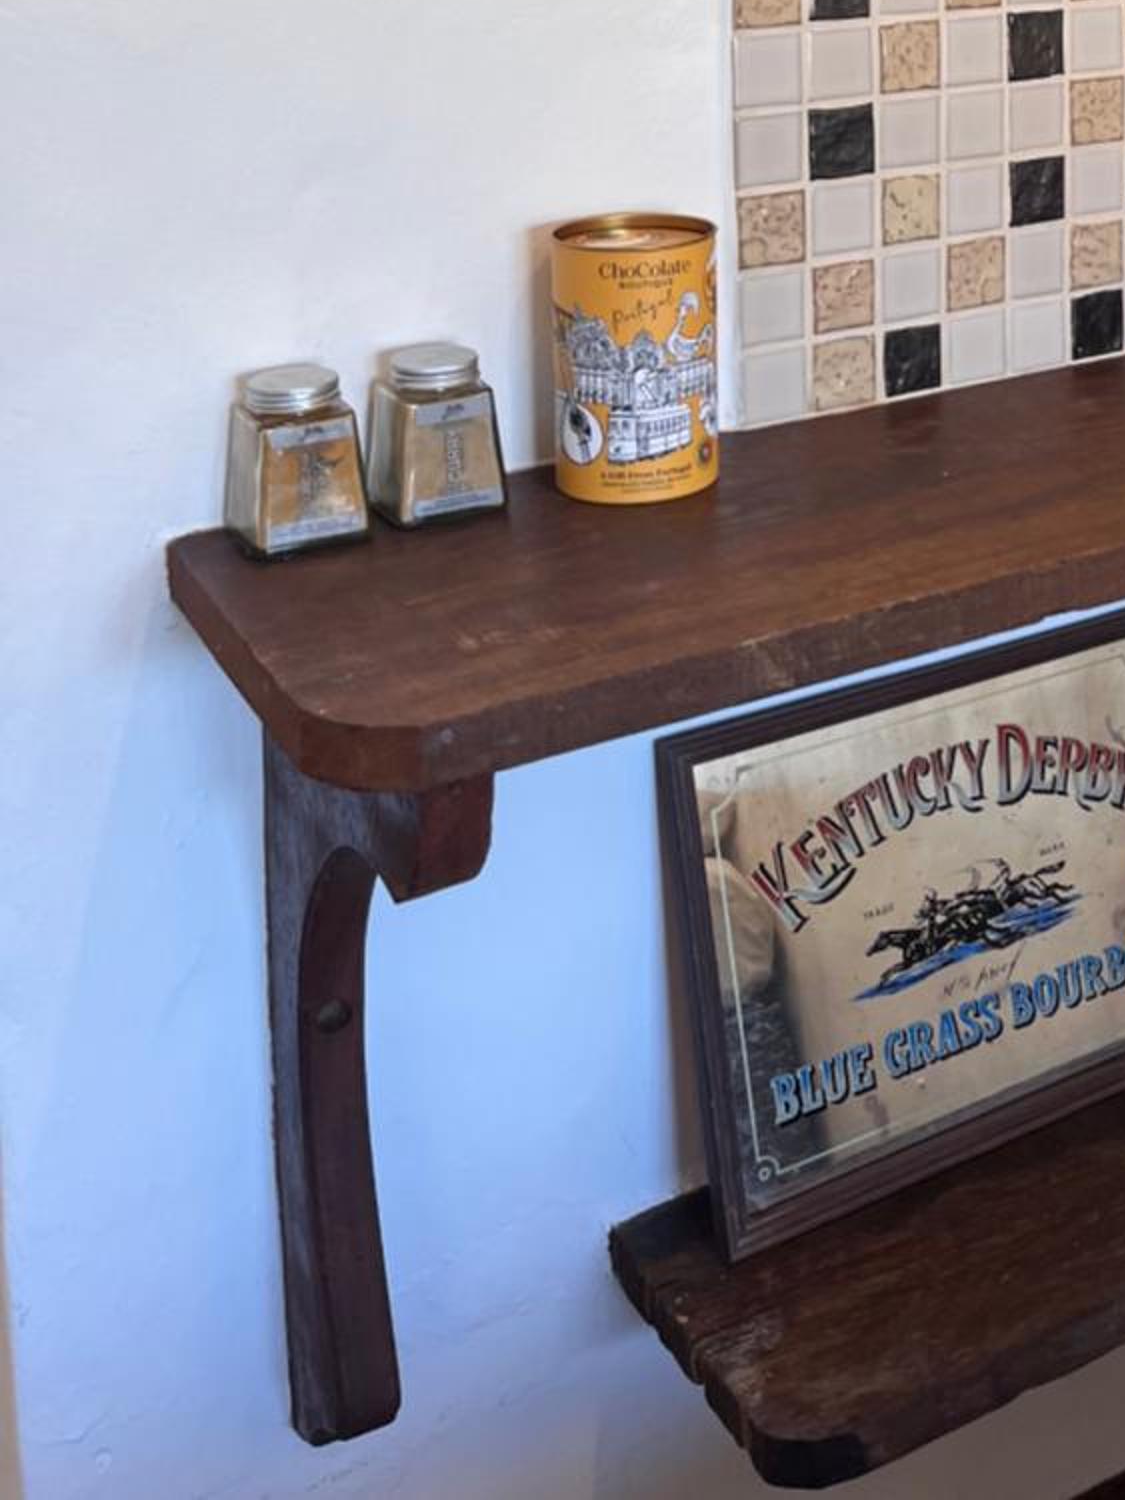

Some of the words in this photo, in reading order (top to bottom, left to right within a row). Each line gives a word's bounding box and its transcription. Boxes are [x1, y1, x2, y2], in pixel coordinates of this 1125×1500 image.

[751, 738, 990, 933] KENTUCKY
[769, 1043, 878, 1128] BLUE
[882, 994, 1004, 1080] GRASS
